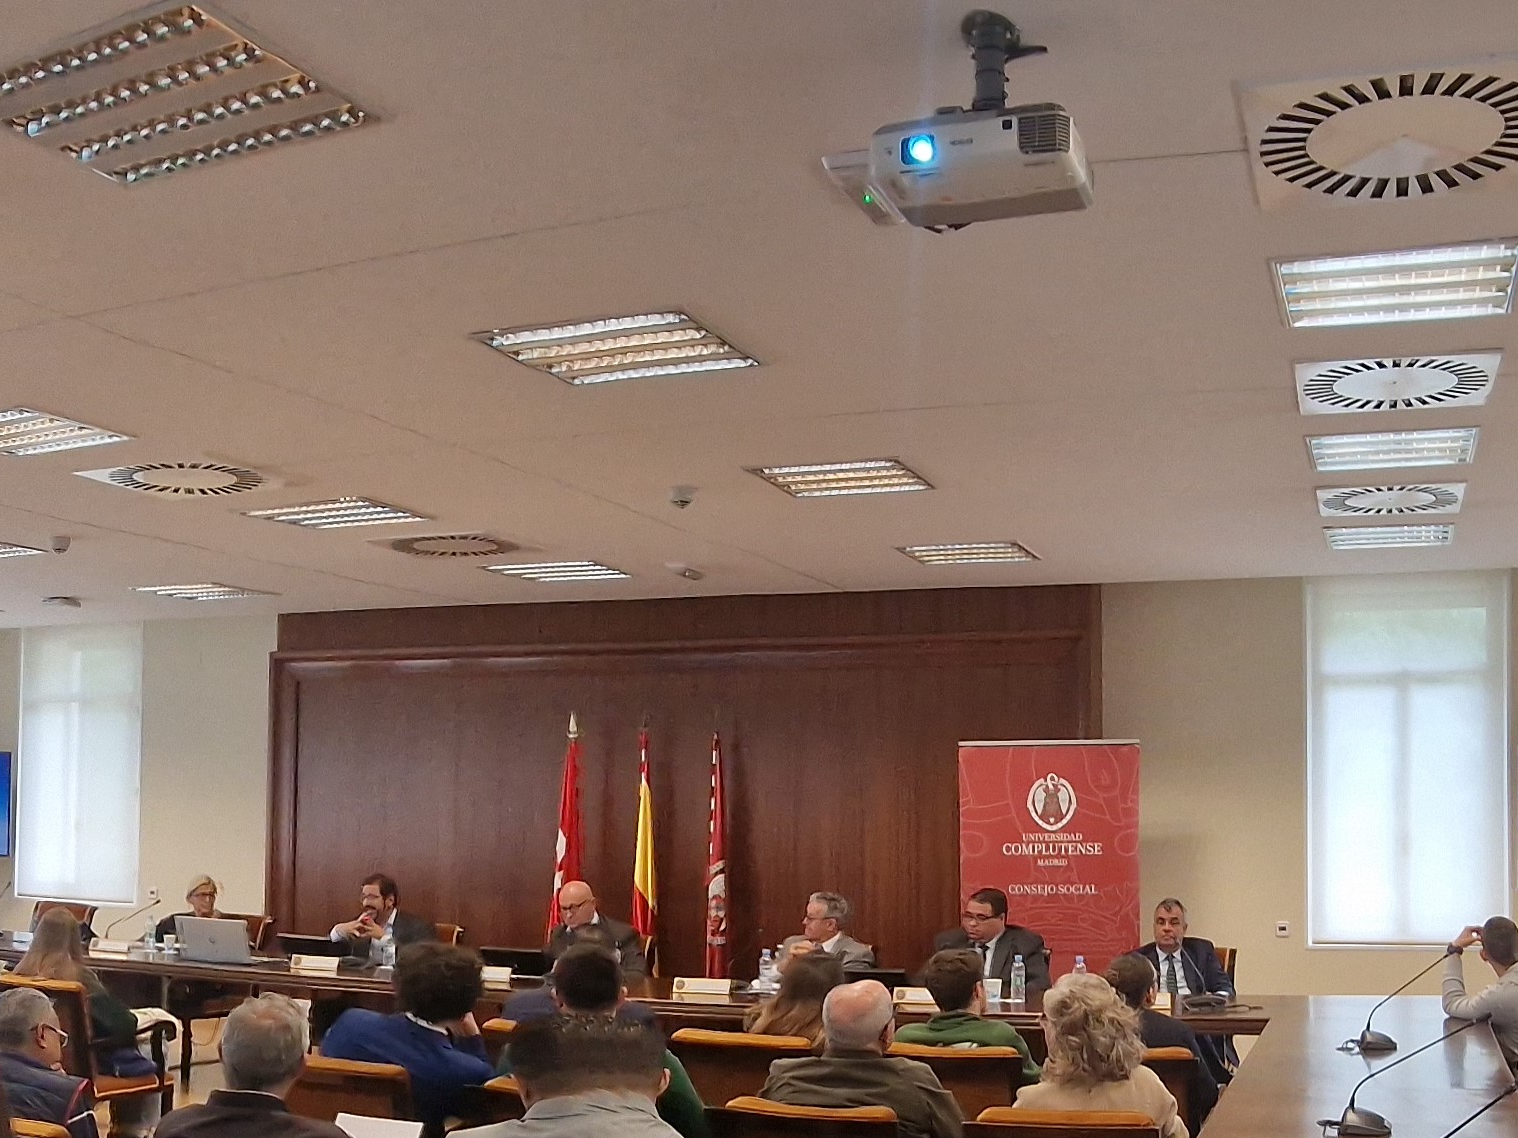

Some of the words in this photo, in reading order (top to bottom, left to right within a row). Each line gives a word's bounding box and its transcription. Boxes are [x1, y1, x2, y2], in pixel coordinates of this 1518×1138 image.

[1022, 833, 1083, 841] UNIVERSIDAD
[1002, 842, 1103, 856] COMPLUTENSE
[1036, 858, 1068, 866] MADRID
[1008, 884, 1056, 896] CONSEJO
[1057, 884, 1098, 894] SOCIAL
